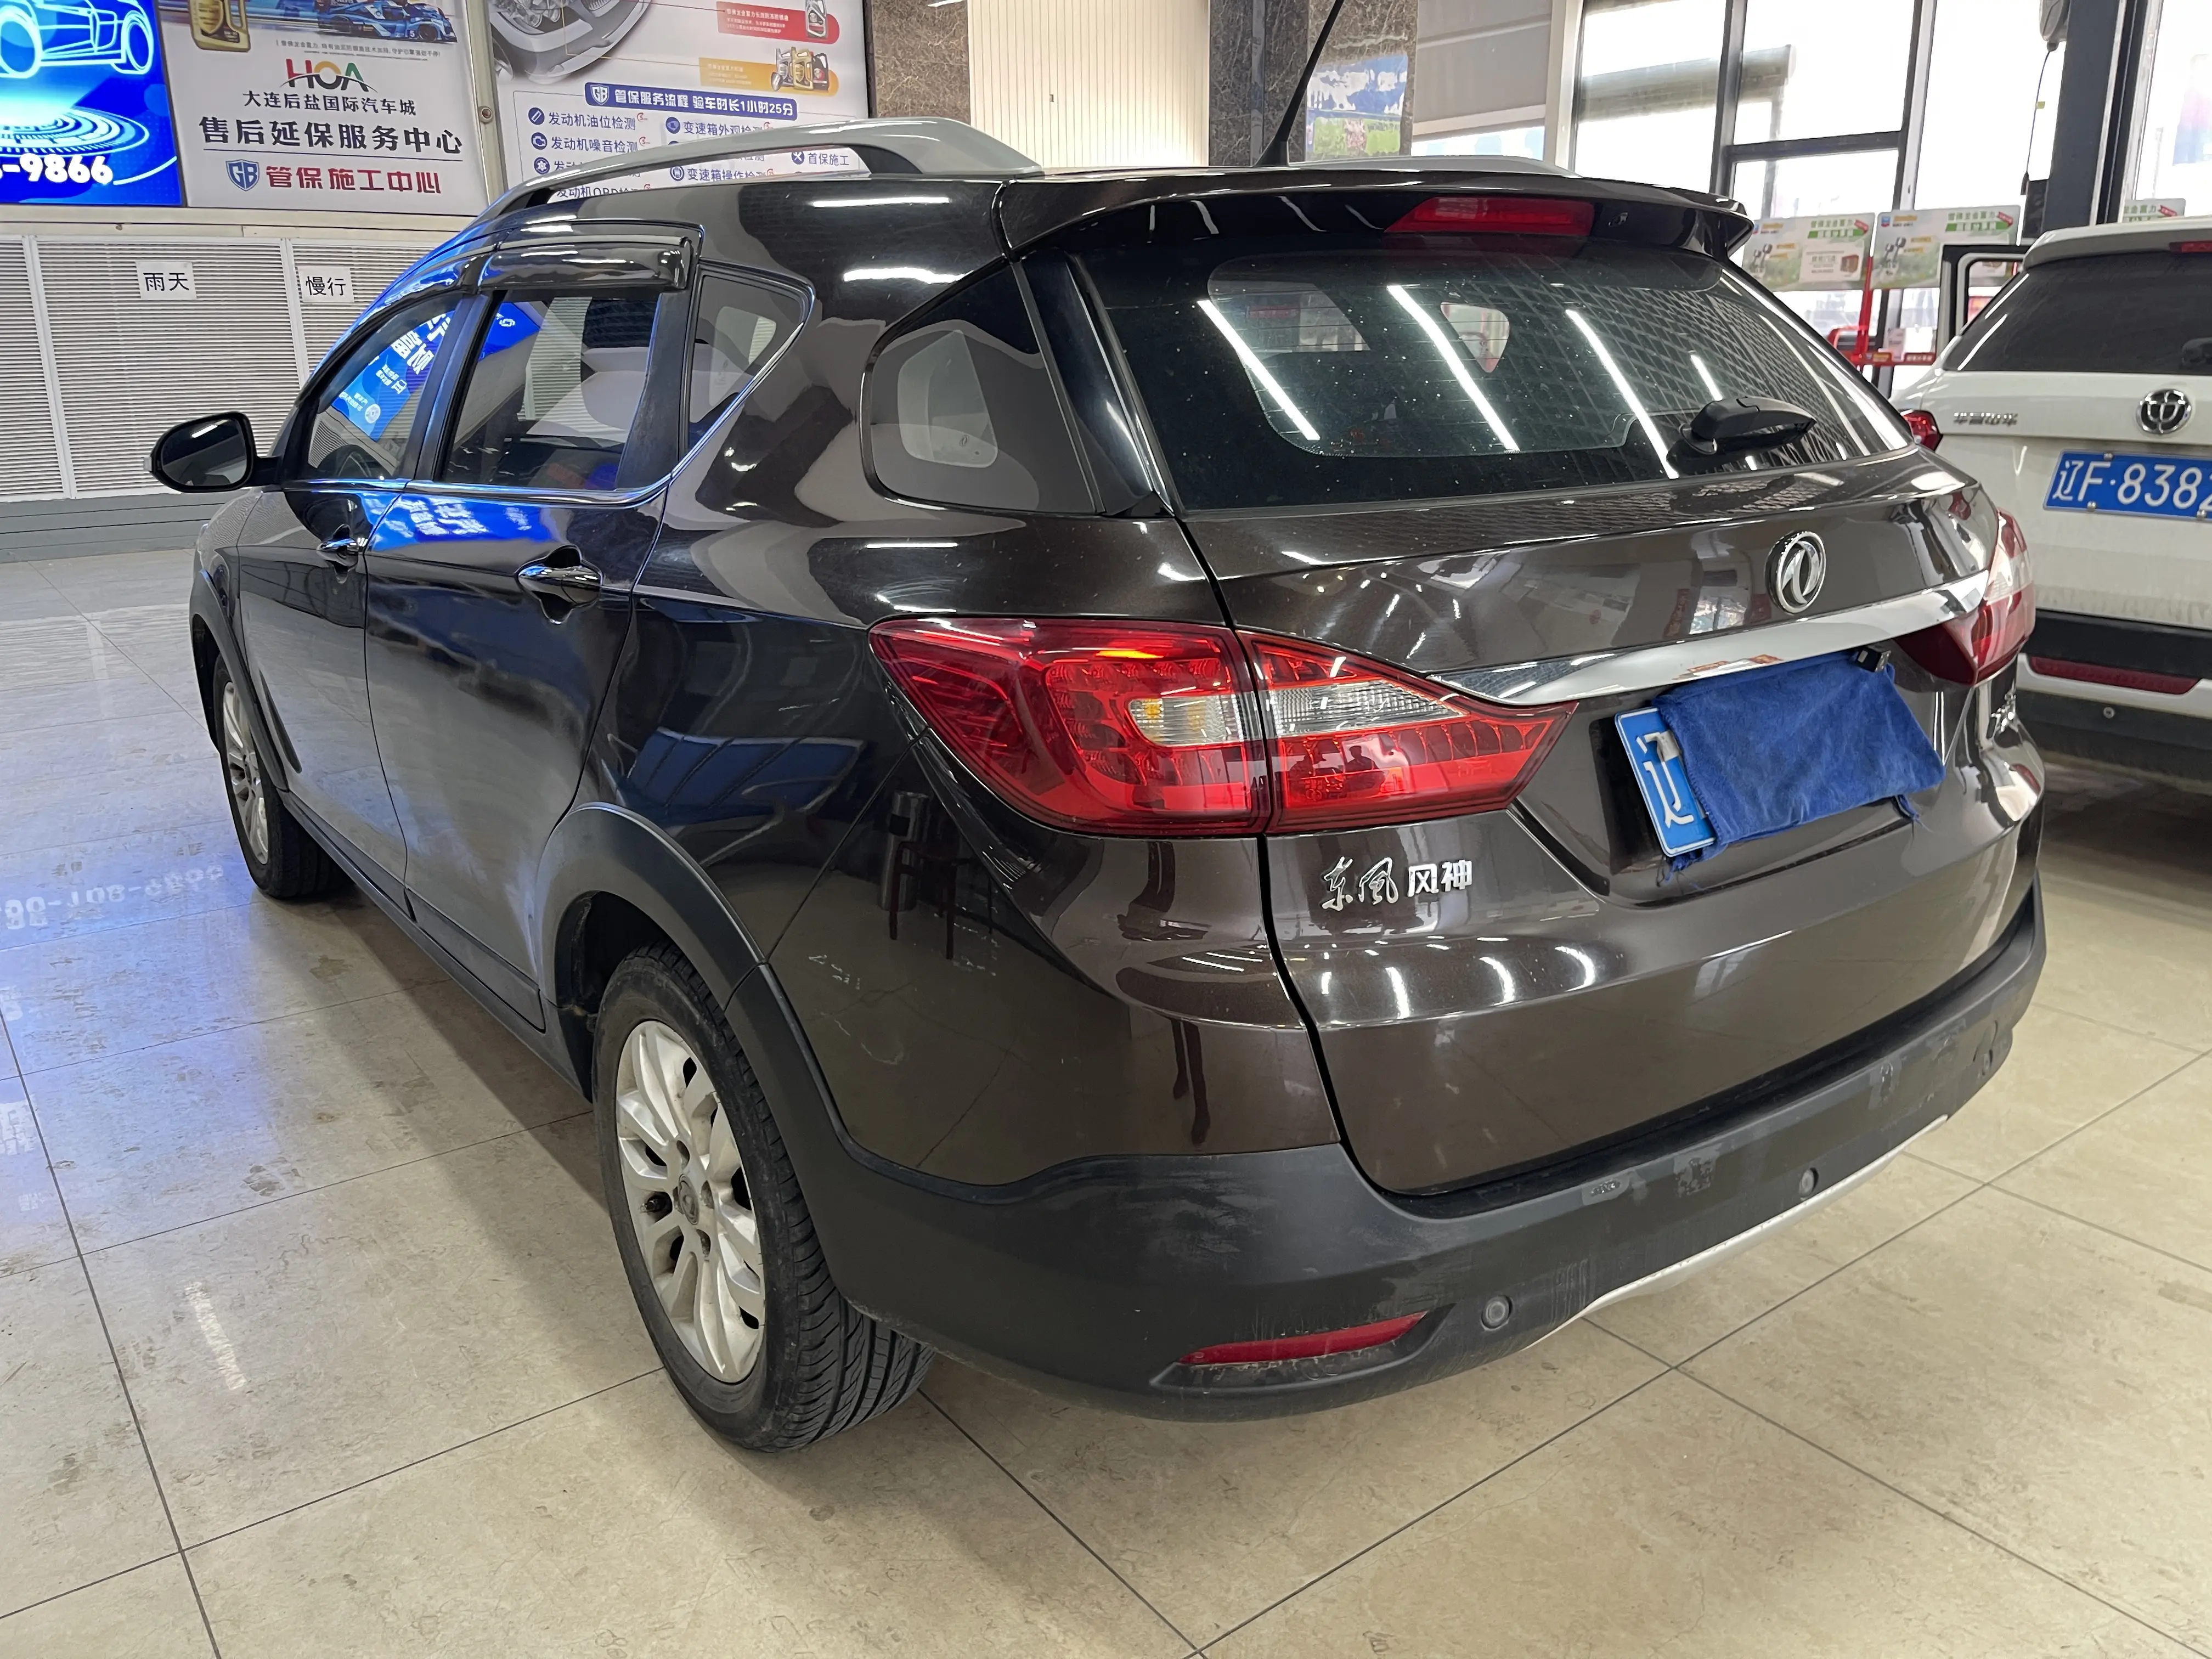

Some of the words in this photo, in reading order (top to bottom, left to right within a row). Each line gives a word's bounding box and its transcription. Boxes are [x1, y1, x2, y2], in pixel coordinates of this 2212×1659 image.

[285, 58, 369, 92] HOA
[243, 91, 417, 116] 大连后盐国际汽车城
[614, 89, 689, 108] 管保服务流程
[692, 95, 793, 116] 验车时长1小时25分
[549, 112, 636, 131] 发动机油位检测
[199, 116, 462, 155] 售后延保服务中心
[551, 137, 639, 153] 发动机噪音检测
[0, 153, 113, 185] -9866
[808, 153, 850, 166] 首保施工
[266, 166, 442, 194] 管保施工中心
[143, 272, 189, 291] 雨天
[305, 276, 347, 296] 慢行
